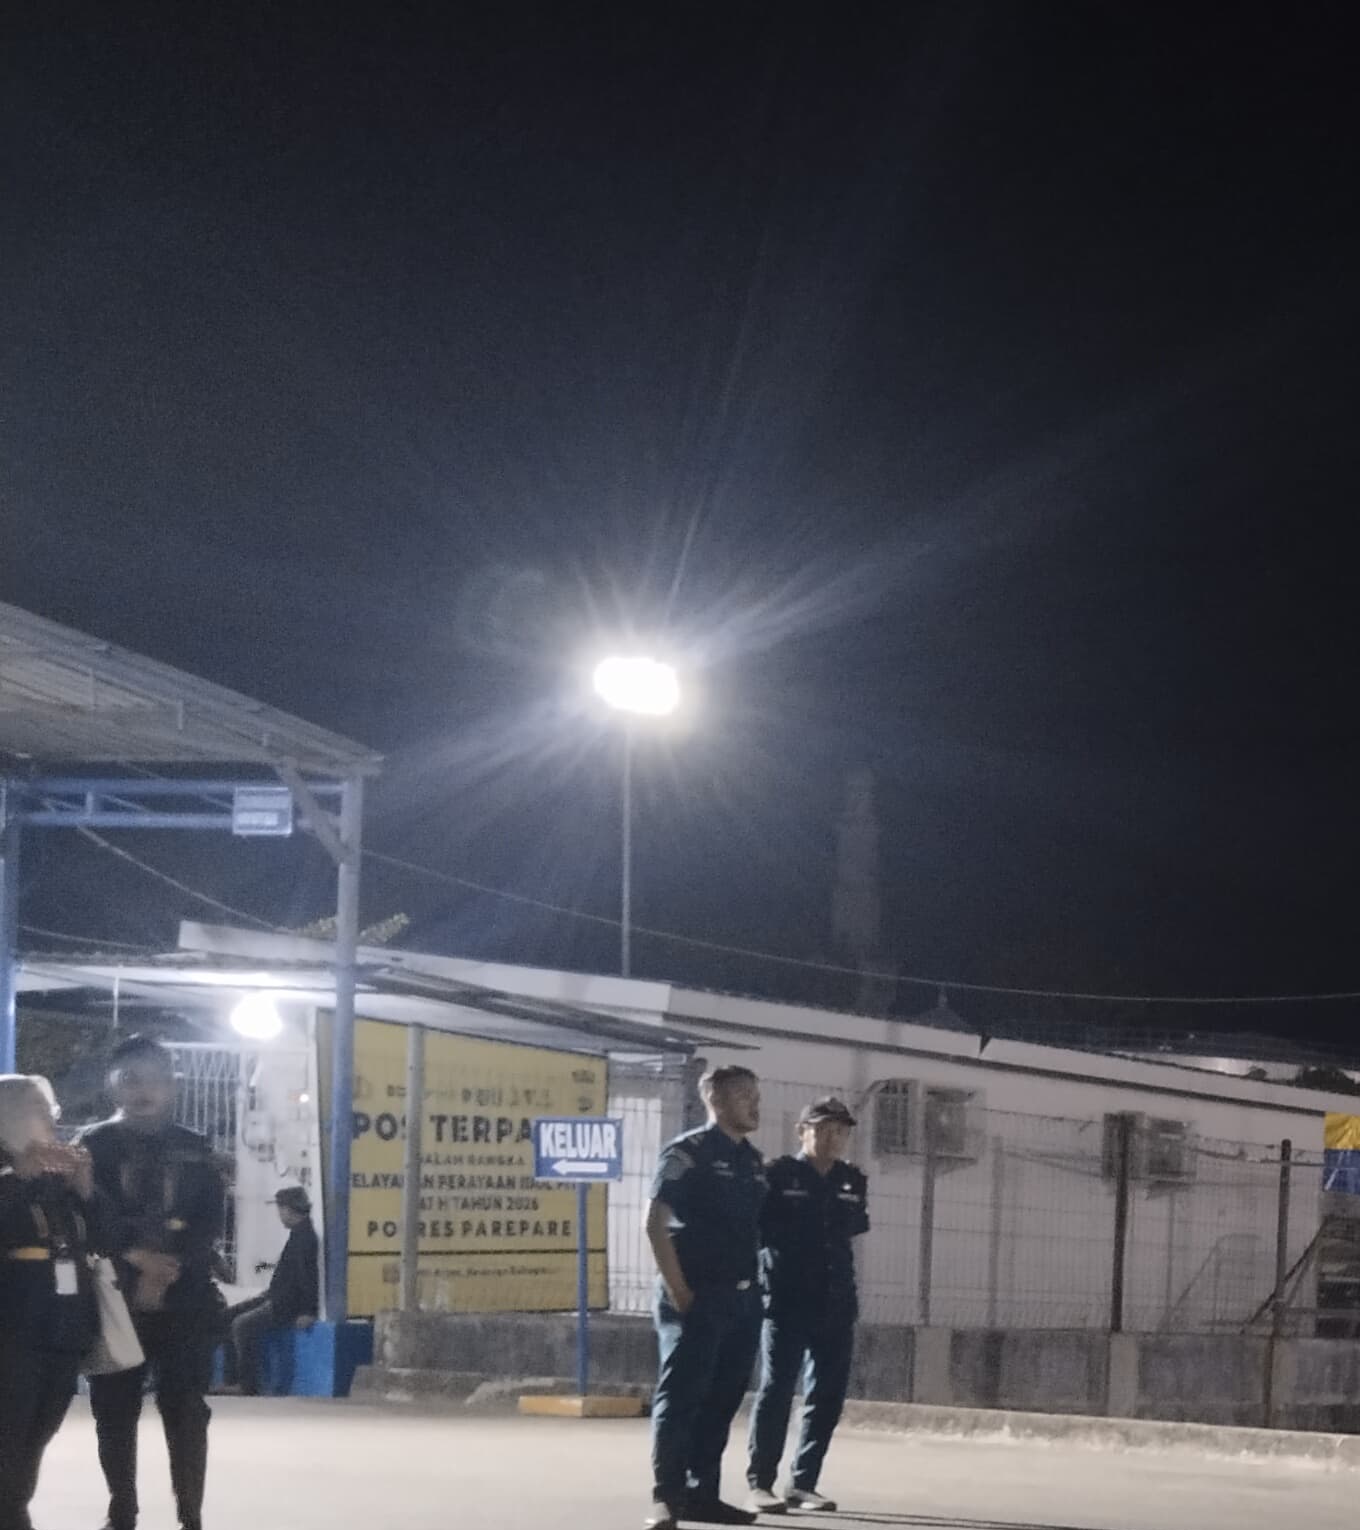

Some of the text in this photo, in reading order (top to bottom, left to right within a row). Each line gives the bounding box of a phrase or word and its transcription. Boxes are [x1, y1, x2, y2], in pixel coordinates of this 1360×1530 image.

[352, 1111, 532, 1144] PO TERPA
[540, 1122, 618, 1159] KELUAR
[367, 1219, 572, 1238] PORES PAREPARE
